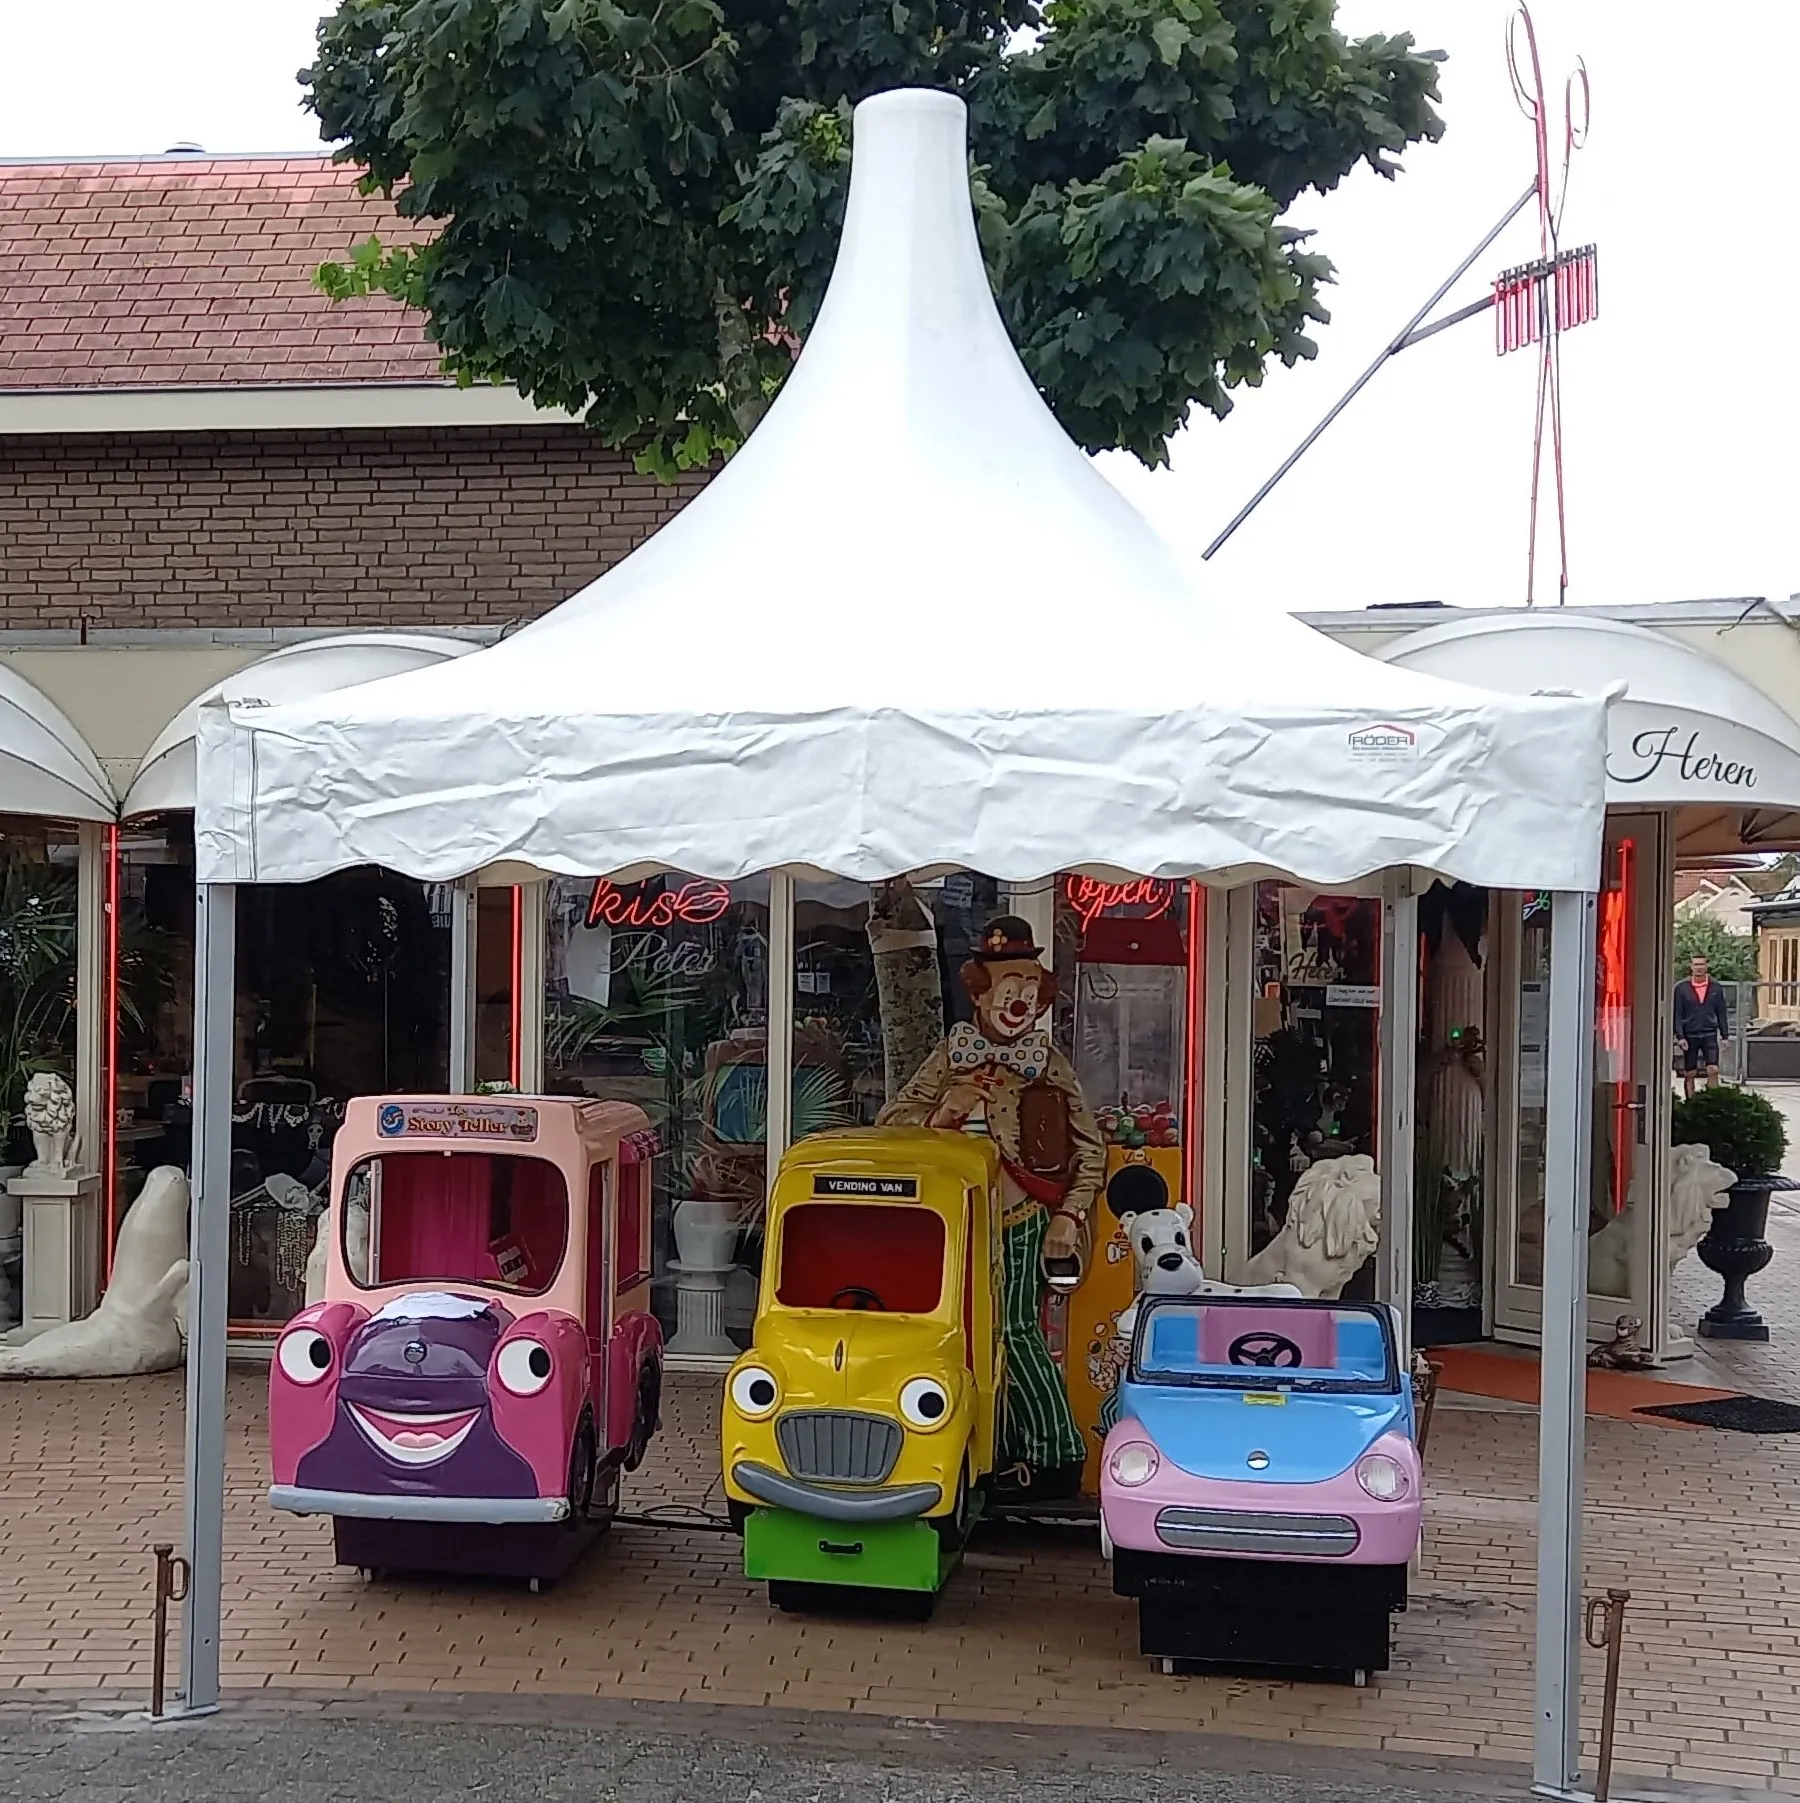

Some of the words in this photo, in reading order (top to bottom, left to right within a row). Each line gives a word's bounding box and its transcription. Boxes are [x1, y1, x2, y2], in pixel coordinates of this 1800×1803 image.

[1352, 734, 1408, 747] RÖDER
[1605, 726, 1758, 788] Heren
[407, 1116, 453, 1135] Story
[457, 1116, 507, 1134] Teller
[828, 1180, 877, 1192] VENDING
[880, 1183, 903, 1193] VAN
